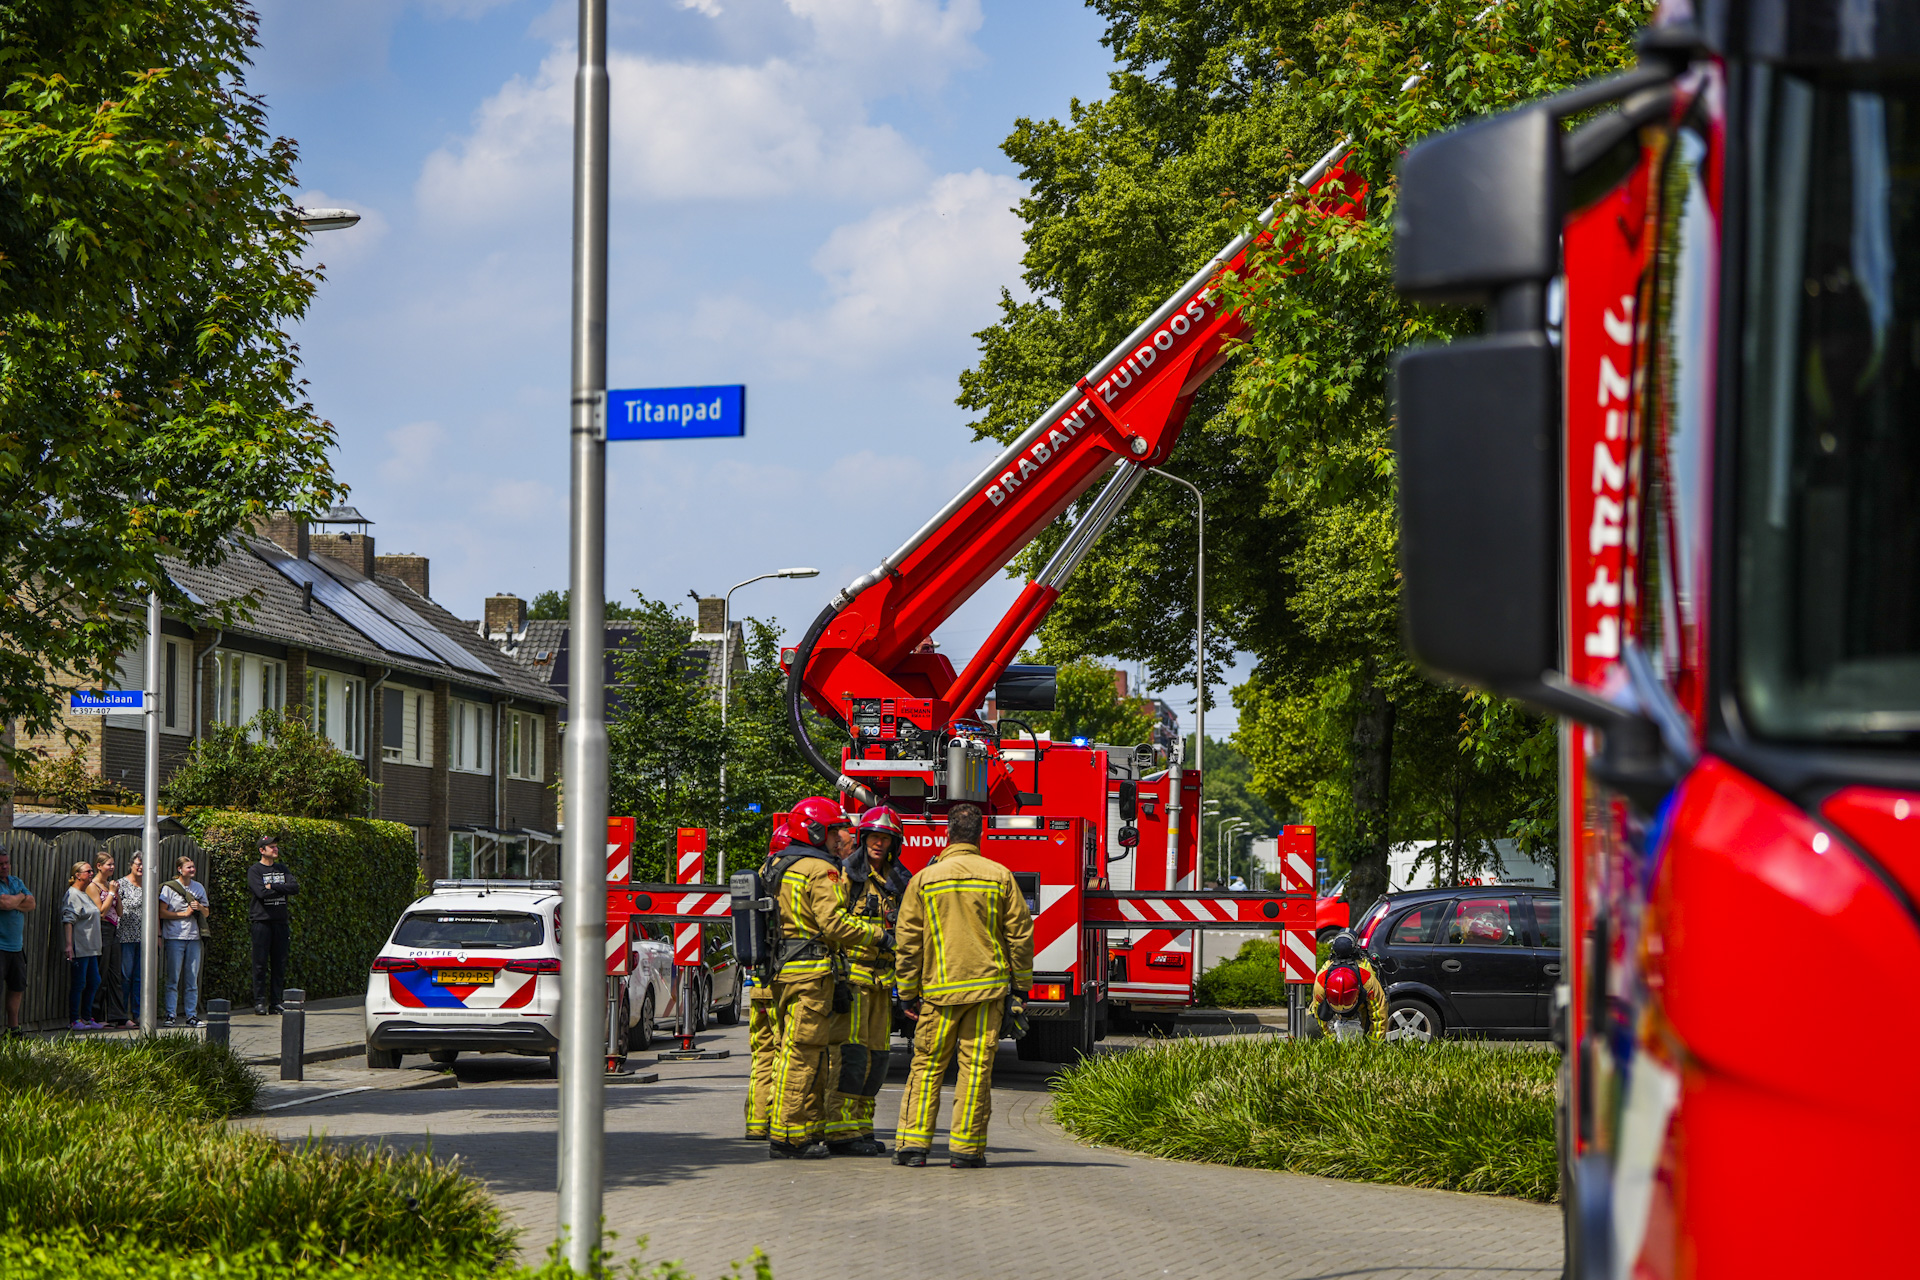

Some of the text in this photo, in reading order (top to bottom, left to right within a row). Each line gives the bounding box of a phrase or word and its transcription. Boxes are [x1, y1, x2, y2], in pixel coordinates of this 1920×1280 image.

[984, 288, 1216, 507] BRABANT ZUIDOOST
[624, 396, 722, 427] Titanpad
[79, 707, 112, 715] 397-407
[440, 971, 490, 982] P-599-PS
